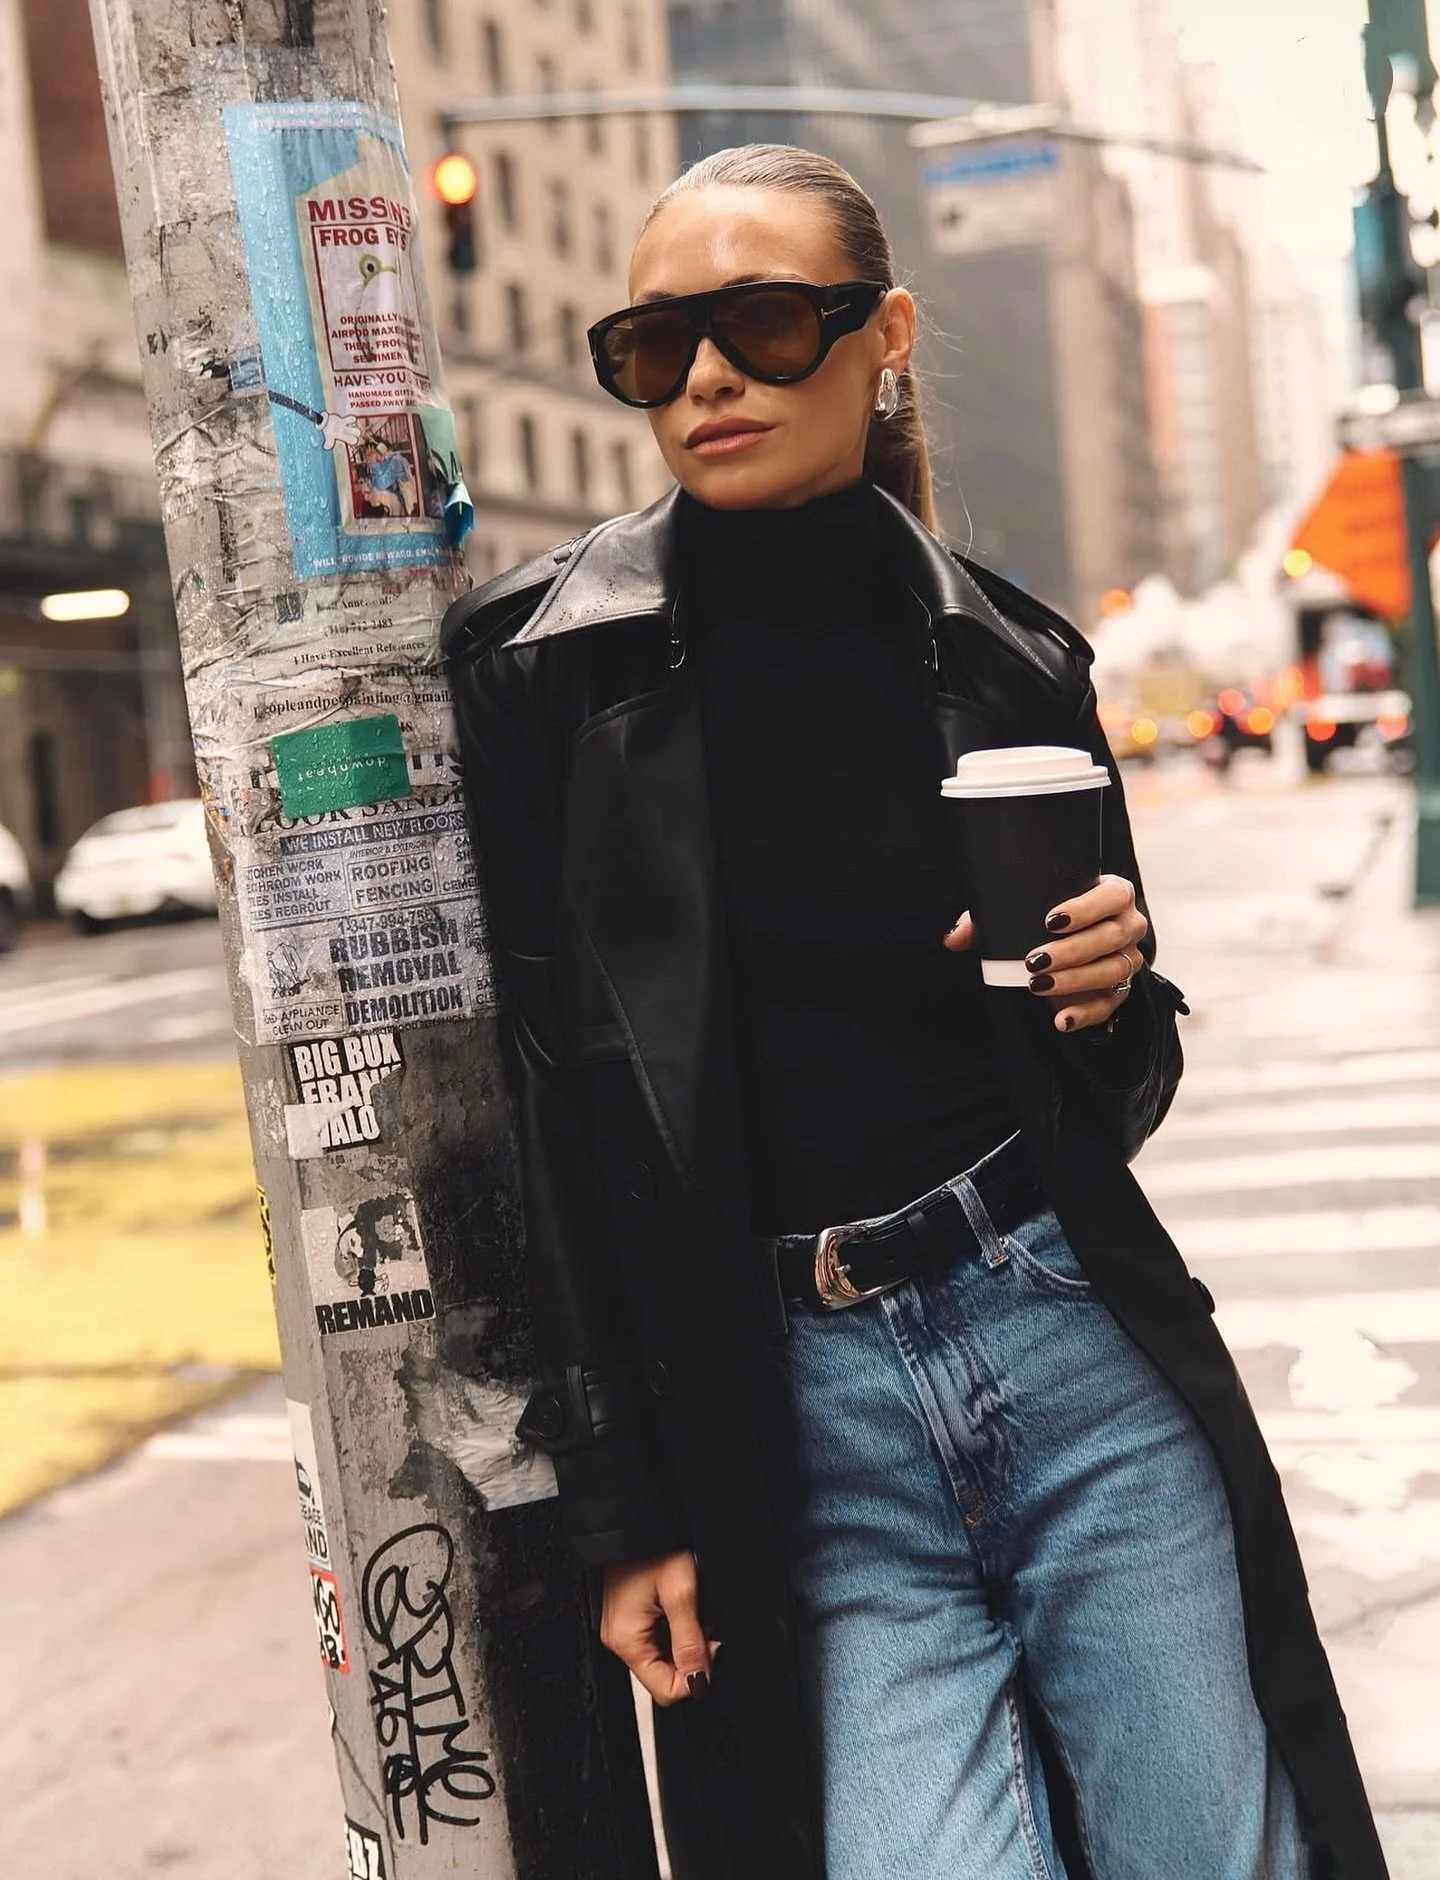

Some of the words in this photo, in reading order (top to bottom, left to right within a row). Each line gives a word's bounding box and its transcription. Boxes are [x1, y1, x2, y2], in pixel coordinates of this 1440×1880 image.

[319, 228, 379, 247] FROG
[385, 227, 406, 250] EYS
[340, 313, 398, 325] ORIGINALLY
[333, 375, 372, 388] HAVE
[376, 372, 406, 385] YOU
[348, 390, 393, 399] HANDMADE
[350, 400, 381, 409] PASSED
[383, 399, 403, 408] AWAY
[301, 651, 326, 663] Have
[330, 645, 373, 658] Excellent
[286, 836, 309, 852] WE
[312, 826, 370, 847] INSTALL
[372, 819, 406, 839] NEW
[286, 859, 325, 874] WORK
[351, 856, 431, 881] ROOFING
[304, 869, 342, 885] WORK
[273, 887, 320, 904] INSTALL
[355, 879, 433, 904] FENCING
[275, 900, 331, 918] REGROUT
[329, 918, 460, 963] RUBBISH
[338, 950, 462, 993] REMOVAL
[345, 984, 464, 1026] DEMOLITION
[305, 1019, 331, 1034] OUT
[293, 1040, 342, 1082] BIG
[343, 1033, 401, 1072] BUX
[315, 1289, 436, 1335] REMAND
